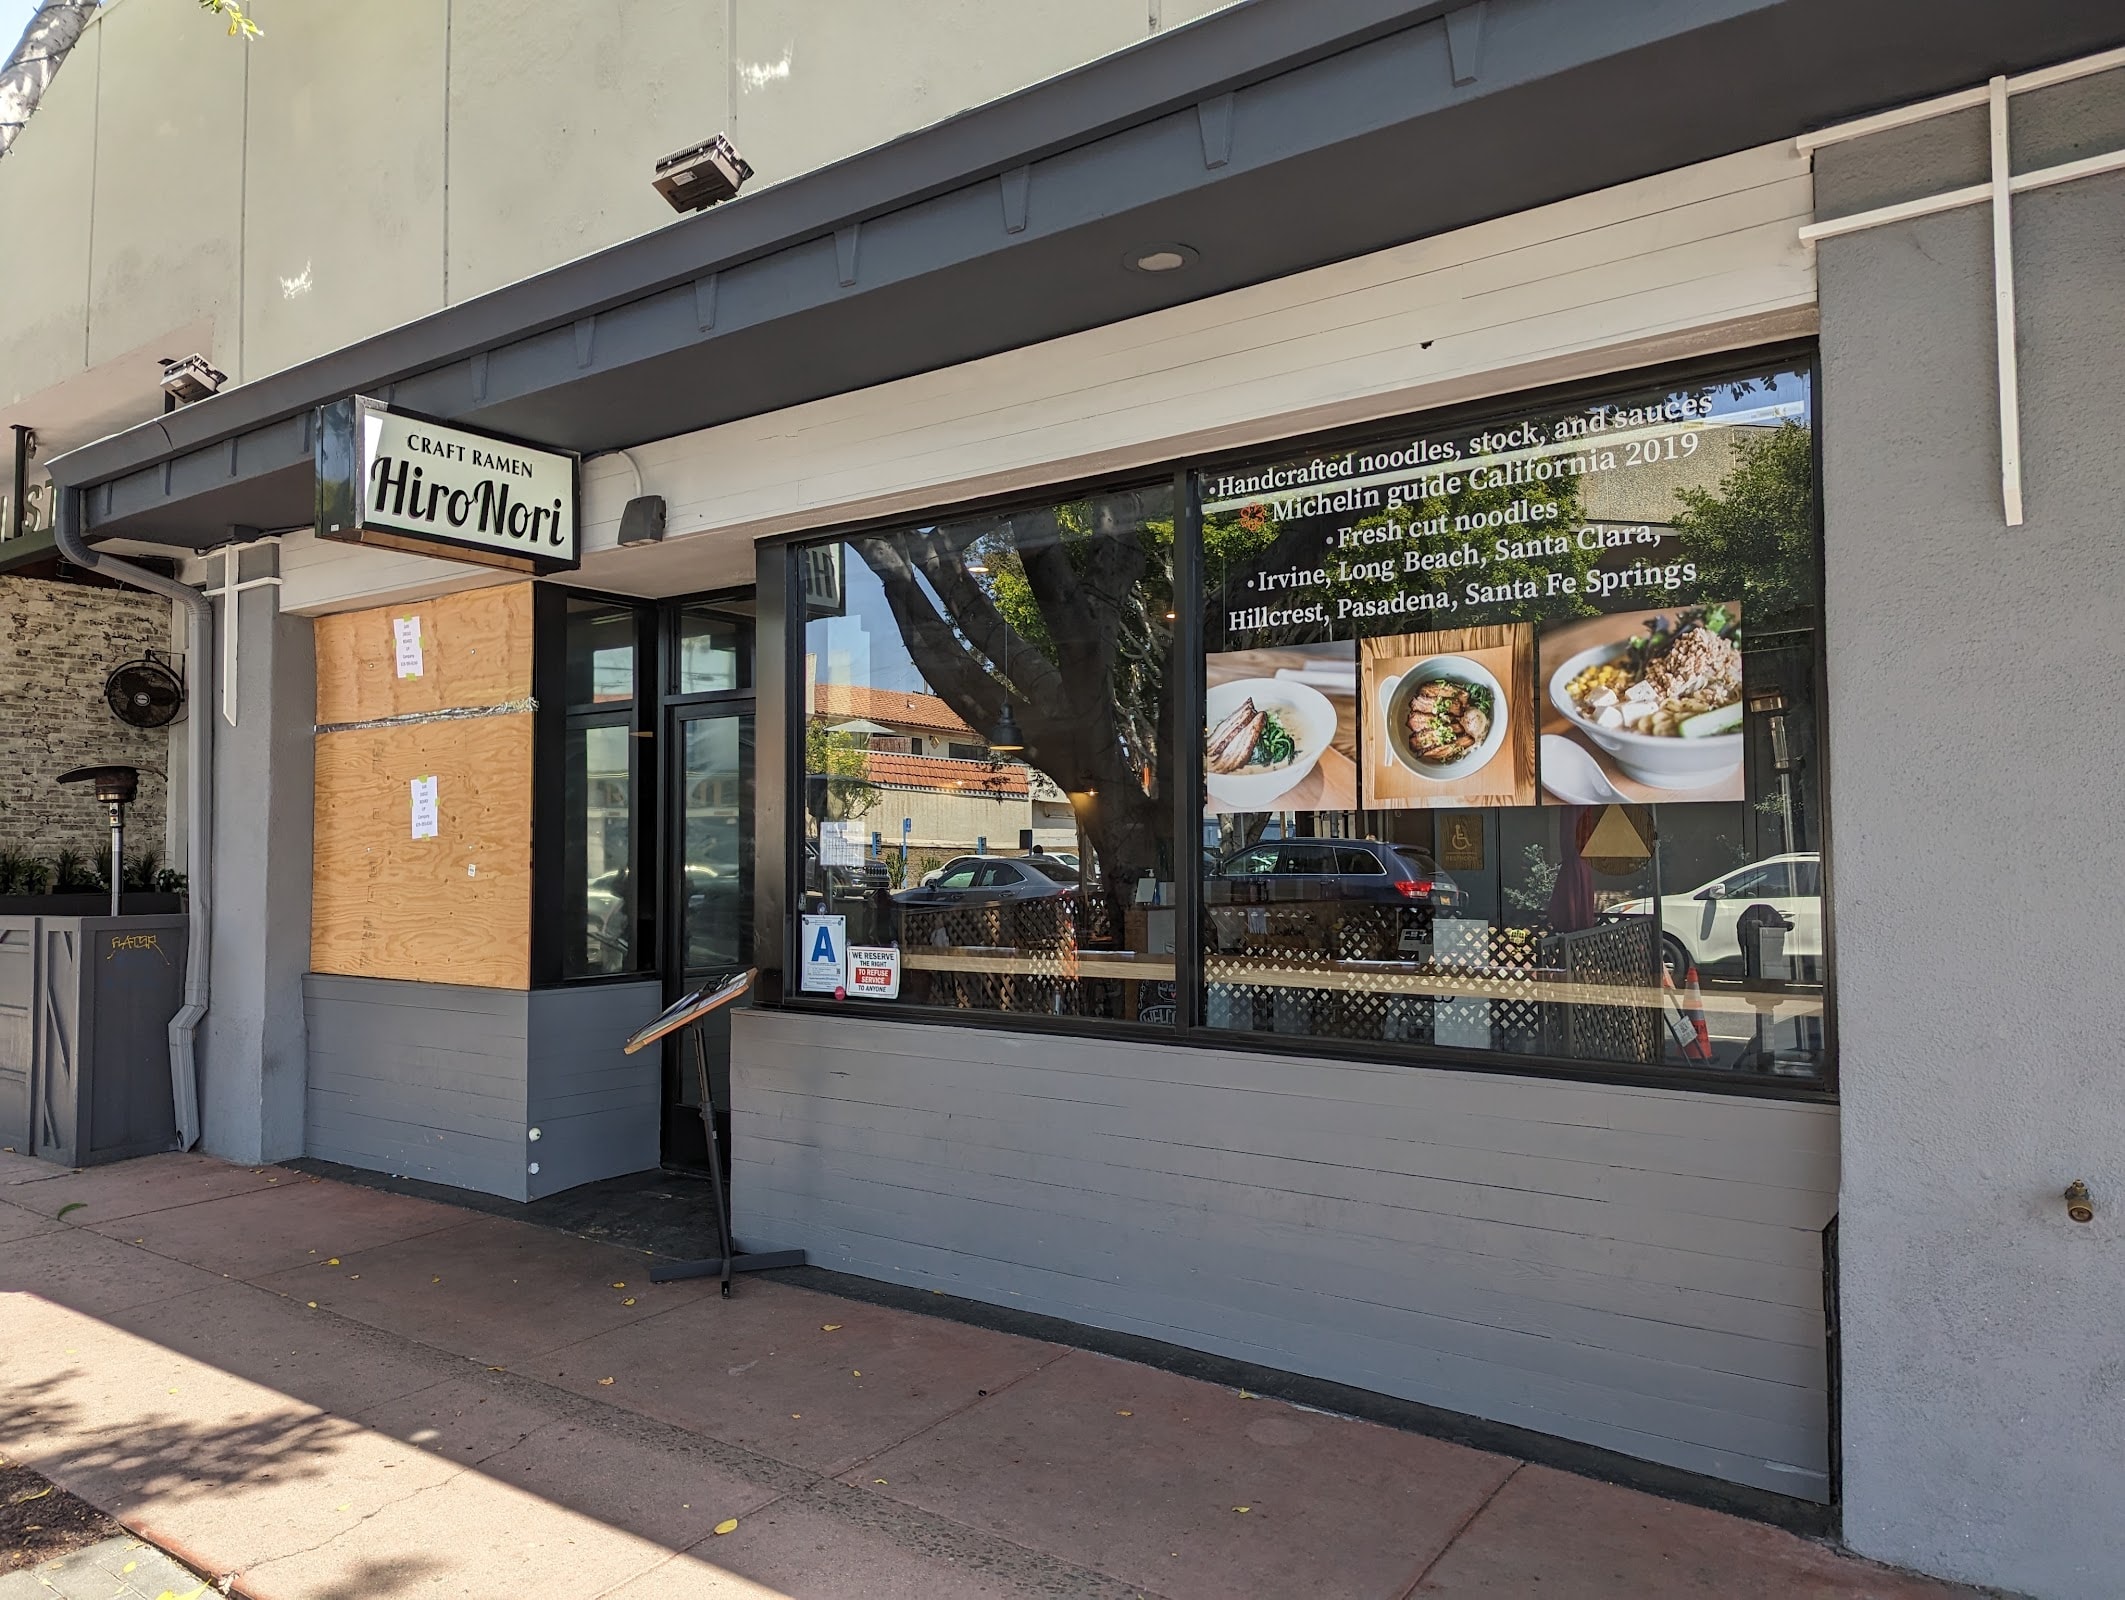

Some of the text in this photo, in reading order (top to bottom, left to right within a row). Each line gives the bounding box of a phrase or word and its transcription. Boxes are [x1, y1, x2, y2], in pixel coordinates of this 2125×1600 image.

[407, 434, 533, 478] CRAFT RAMEN
[1217, 394, 1713, 498] Handcrafted noodles, stock, and sauces
[1271, 432, 1699, 522] Michelin guide California 2019
[1337, 500, 1558, 549] Fresh cut noodles
[1257, 523, 1661, 592] Irvine, Long Beach, Santa Clara,
[1228, 561, 1698, 631] Hillcrest, Pasadena, Santa Fe Springs
[811, 926, 836, 962] A
[864, 952, 894, 960] RESERVE
[861, 976, 885, 984] SERVICE
[866, 969, 889, 977] REFUSE
